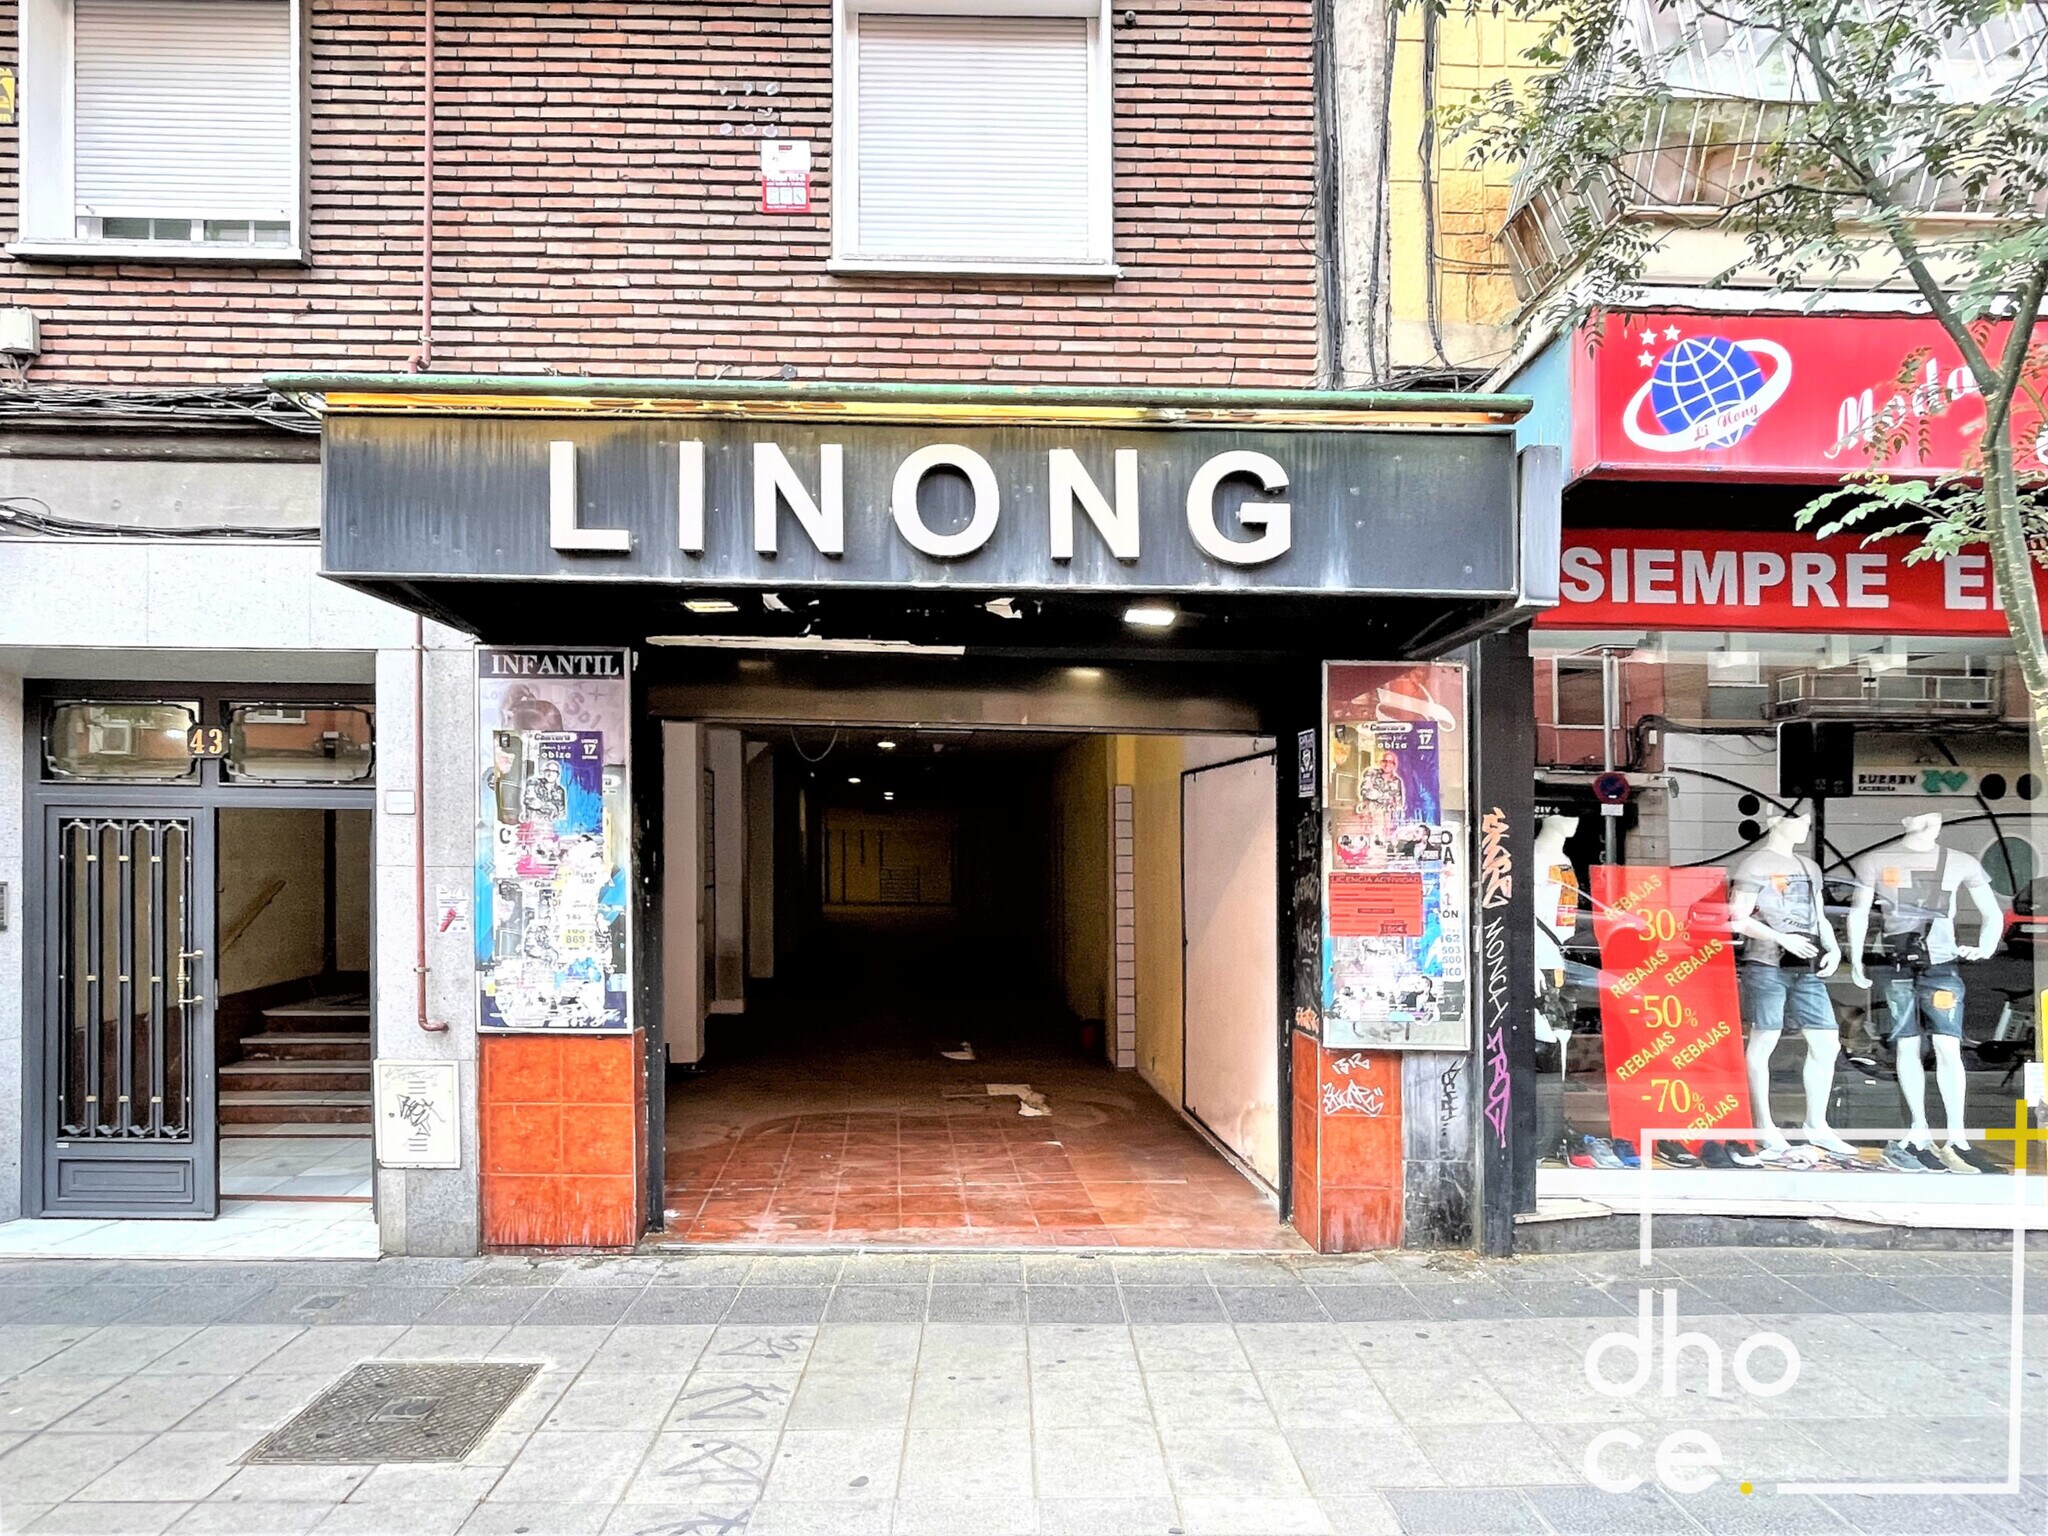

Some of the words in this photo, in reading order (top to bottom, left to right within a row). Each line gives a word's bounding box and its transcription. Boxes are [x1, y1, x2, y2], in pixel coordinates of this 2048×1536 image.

[548, 440, 1292, 565] LINONG
[1560, 546, 1891, 610] SIEMPRE
[491, 654, 620, 676] INFANTIL
[189, 728, 223, 754] 43
[583, 743, 597, 755] 17
[1602, 874, 1662, 922] REBAJAS
[1609, 949, 1670, 999] REBAJAS
[1664, 939, 1724, 987] REBAJAS
[1629, 994, 1698, 1028] -50%
[1616, 1031, 1676, 1081] REBAJAS
[1671, 1021, 1731, 1070] REBAJAS
[1641, 1079, 1705, 1113] -70%
[1680, 1094, 1739, 1144] REBAJAS
